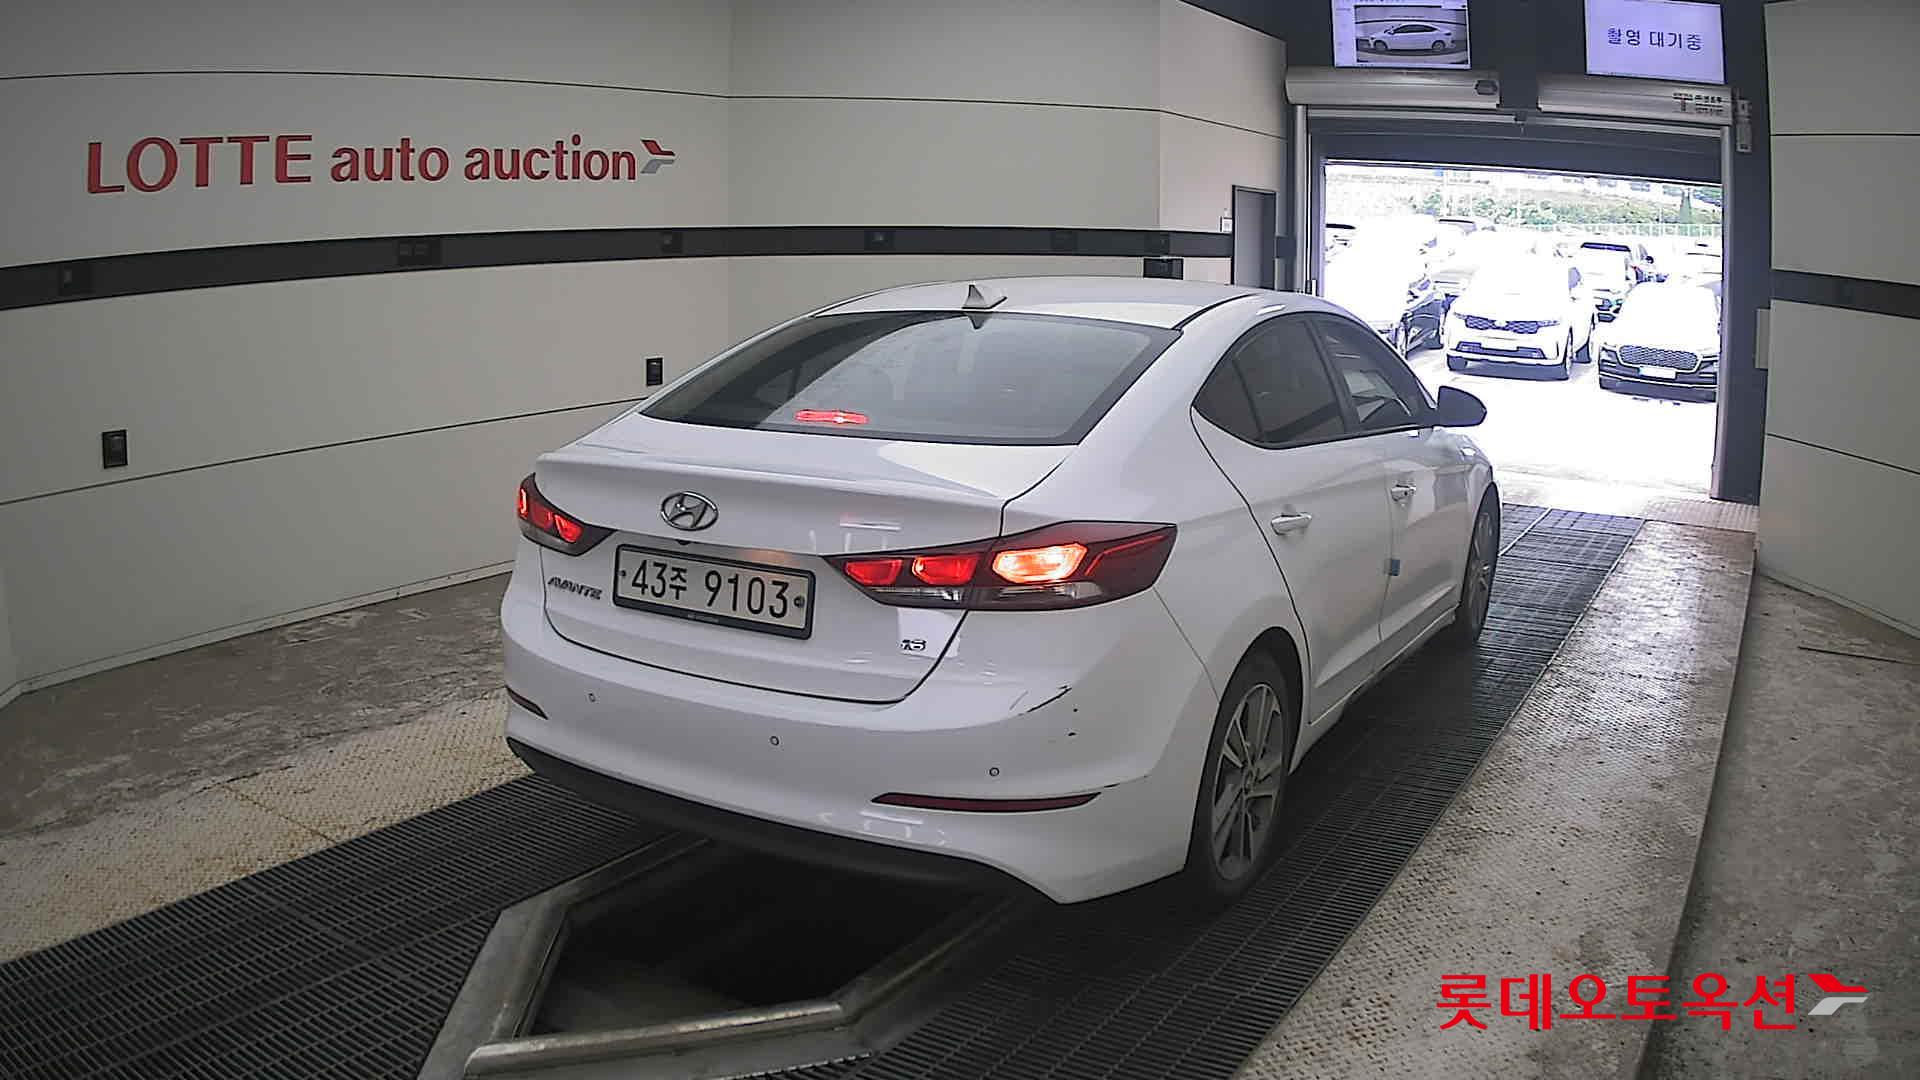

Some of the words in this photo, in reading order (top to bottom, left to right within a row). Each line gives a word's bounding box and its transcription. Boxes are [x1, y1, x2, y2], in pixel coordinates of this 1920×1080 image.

[1608, 27, 1641, 46] 촬영
[1649, 30, 1702, 51] 대기중
[87, 134, 312, 194] LOTTE
[330, 138, 450, 182] auto
[463, 134, 636, 182] auction
[547, 575, 603, 600] AVANTE
[631, 559, 688, 602] 43주
[705, 569, 789, 619] 9103
